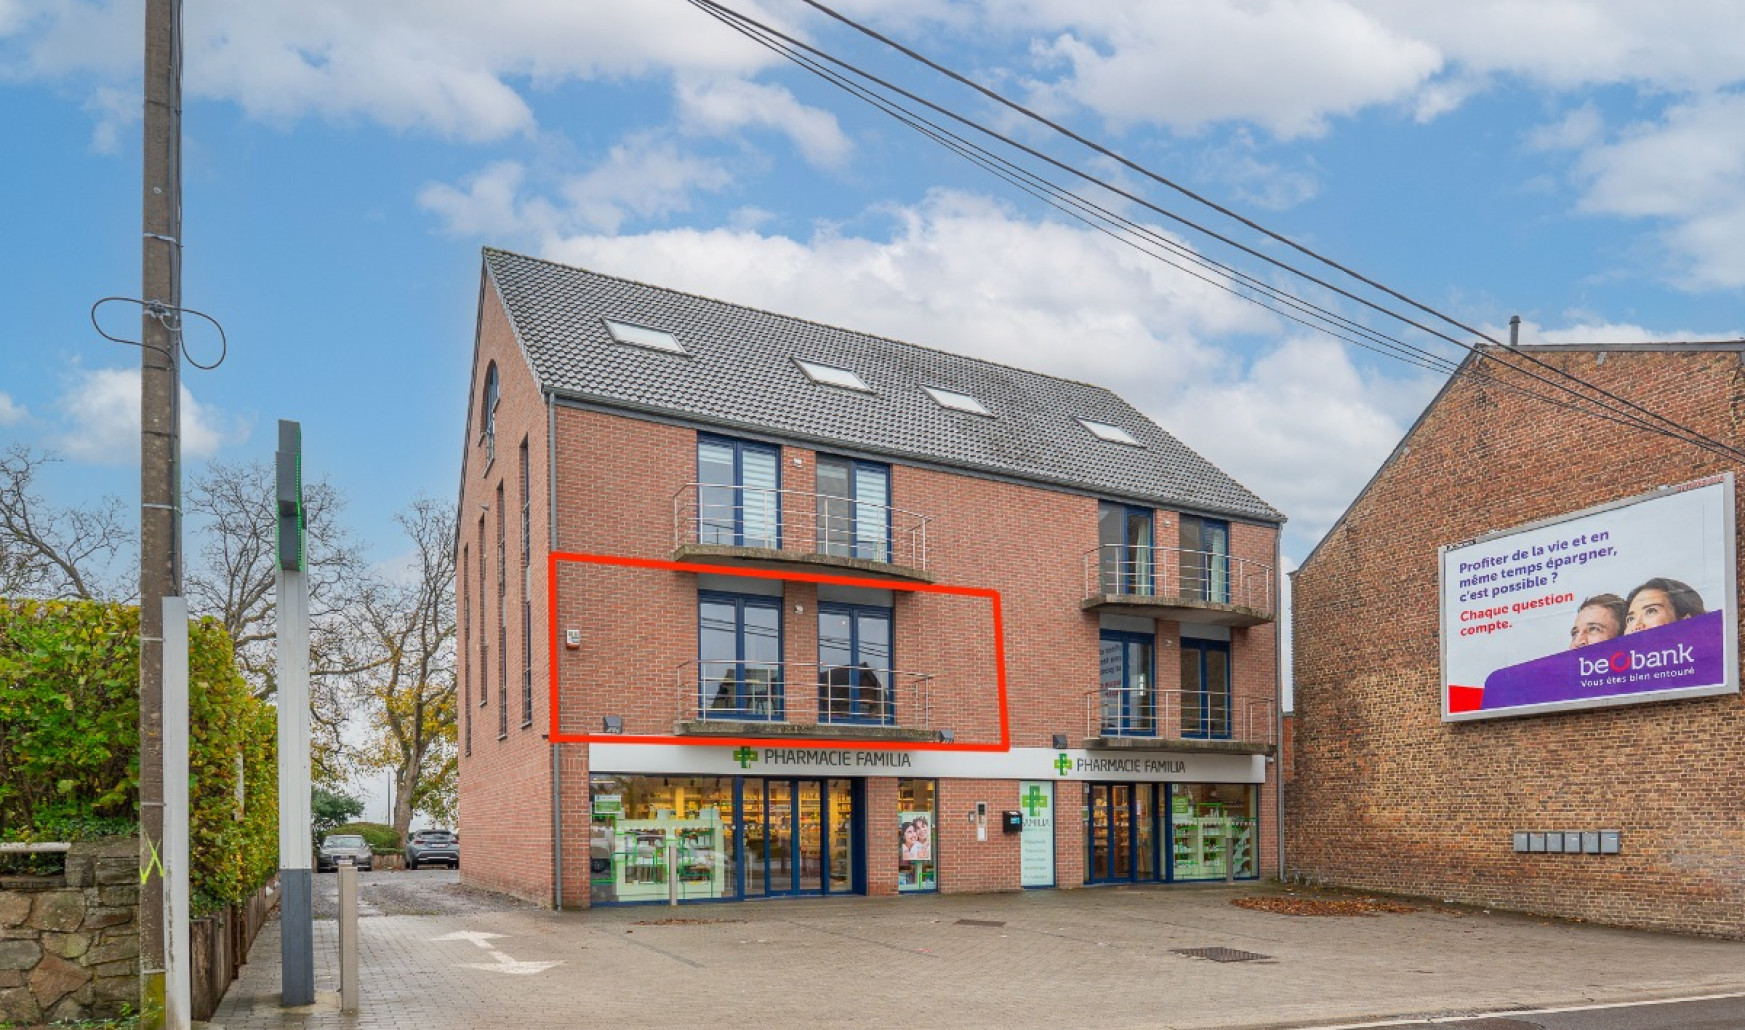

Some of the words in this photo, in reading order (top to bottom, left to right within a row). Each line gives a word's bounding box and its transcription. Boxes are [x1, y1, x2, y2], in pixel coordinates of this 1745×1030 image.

[1459, 554, 1508, 573] Profiter
[1511, 549, 1529, 561] de
[1532, 546, 1544, 557] la
[1547, 539, 1568, 553] vie
[1572, 535, 1587, 547] et
[1590, 530, 1609, 543] en
[1459, 572, 1498, 588] même
[1501, 562, 1542, 579] temps
[1546, 546, 1618, 570] épargner,
[1459, 587, 1489, 602] c'est
[1491, 575, 1548, 598] possible
[1460, 604, 1509, 622] Chaque
[1511, 592, 1574, 615] question
[1460, 619, 1513, 637] compte.
[1581, 679, 1604, 688] Vous
[1606, 675, 1627, 685] êtes
[1629, 672, 1650, 682] bien
[1653, 666, 1695, 679] entouré
[764, 748, 851, 766] PHARMACIE
[856, 751, 911, 768] FAMILIA
[1077, 758, 1140, 772] PHARMACIE
[1144, 760, 1186, 773] FAMILIA
[1022, 818, 1051, 827] AMILIA
